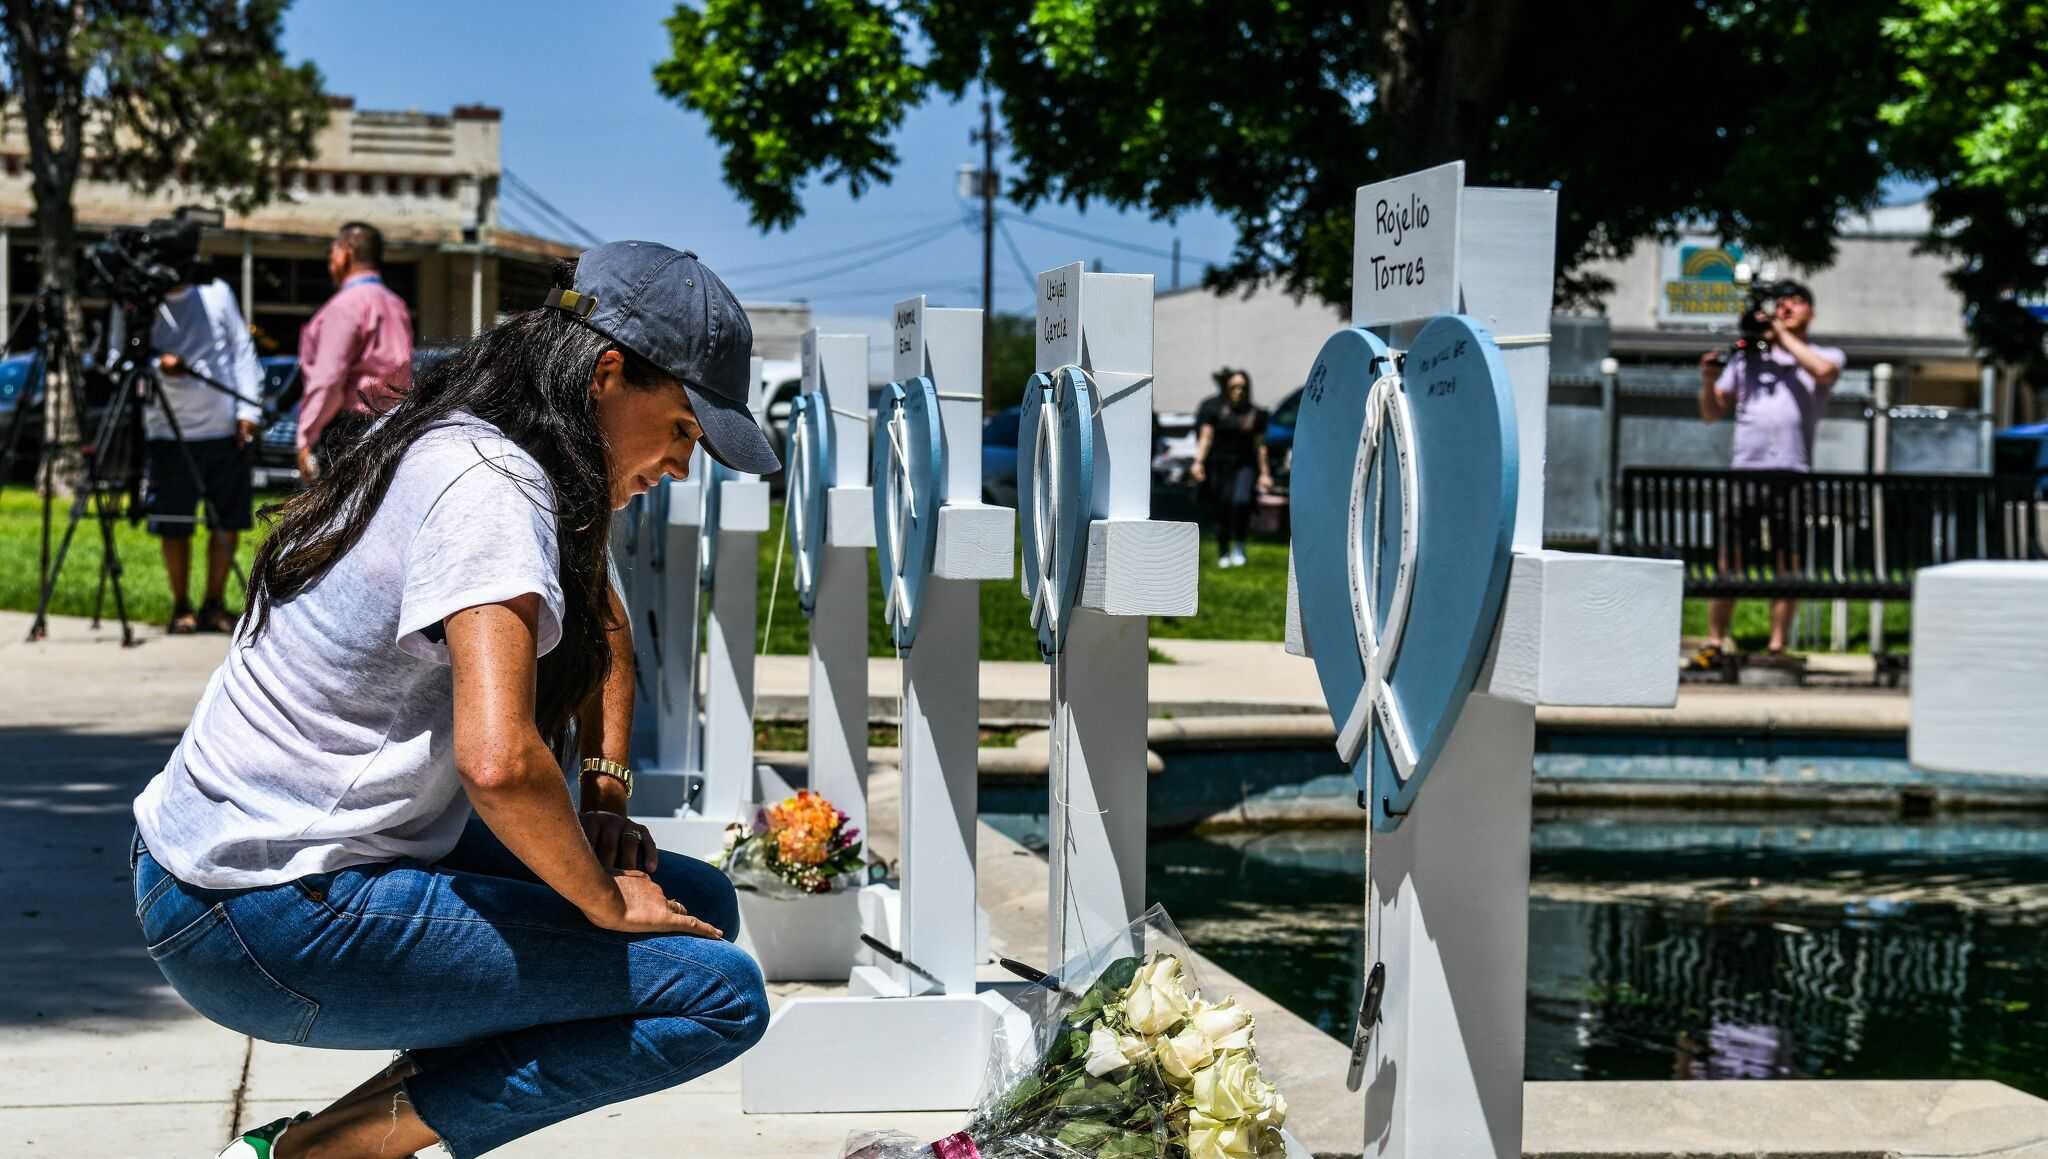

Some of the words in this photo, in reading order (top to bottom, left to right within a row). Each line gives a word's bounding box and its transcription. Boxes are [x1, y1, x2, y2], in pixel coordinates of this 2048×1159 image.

[1376, 193, 1430, 247] Rojelio
[1370, 255, 1425, 291] Torres
[1044, 316, 1068, 345] Garcia
